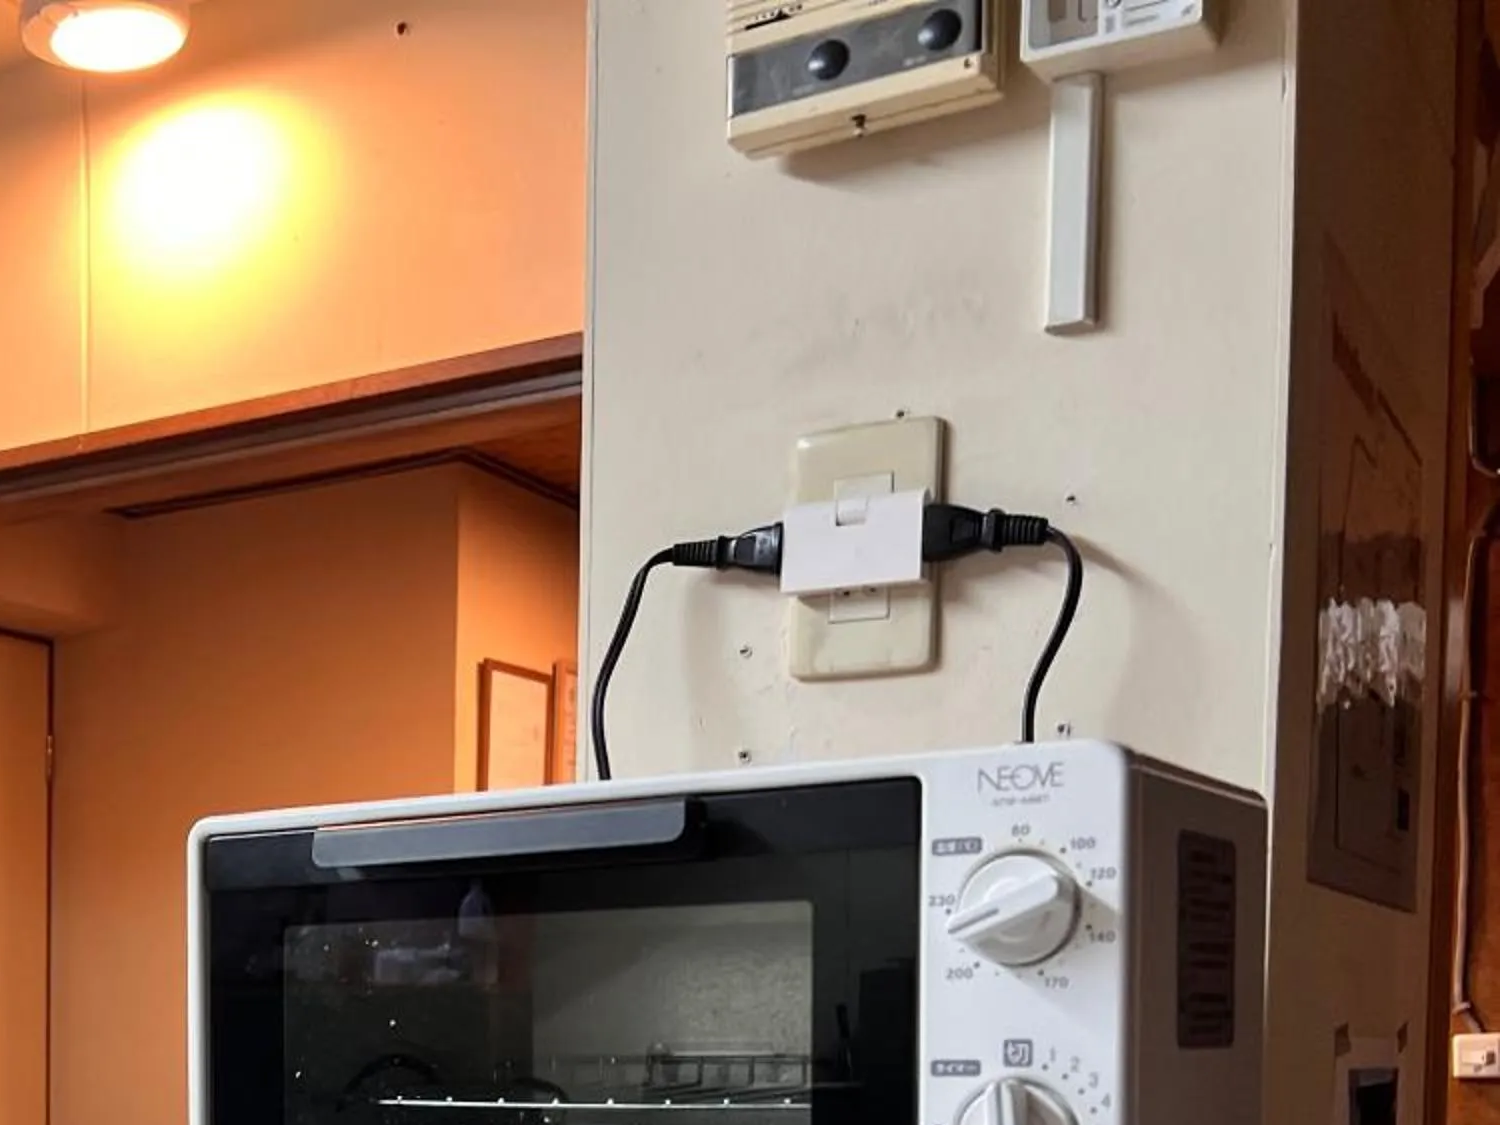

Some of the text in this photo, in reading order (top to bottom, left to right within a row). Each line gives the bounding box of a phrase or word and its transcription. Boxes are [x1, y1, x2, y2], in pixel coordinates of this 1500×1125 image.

[977, 762, 1065, 793] NEOVE
[1070, 837, 1096, 849] 100
[946, 967, 974, 980] 200
